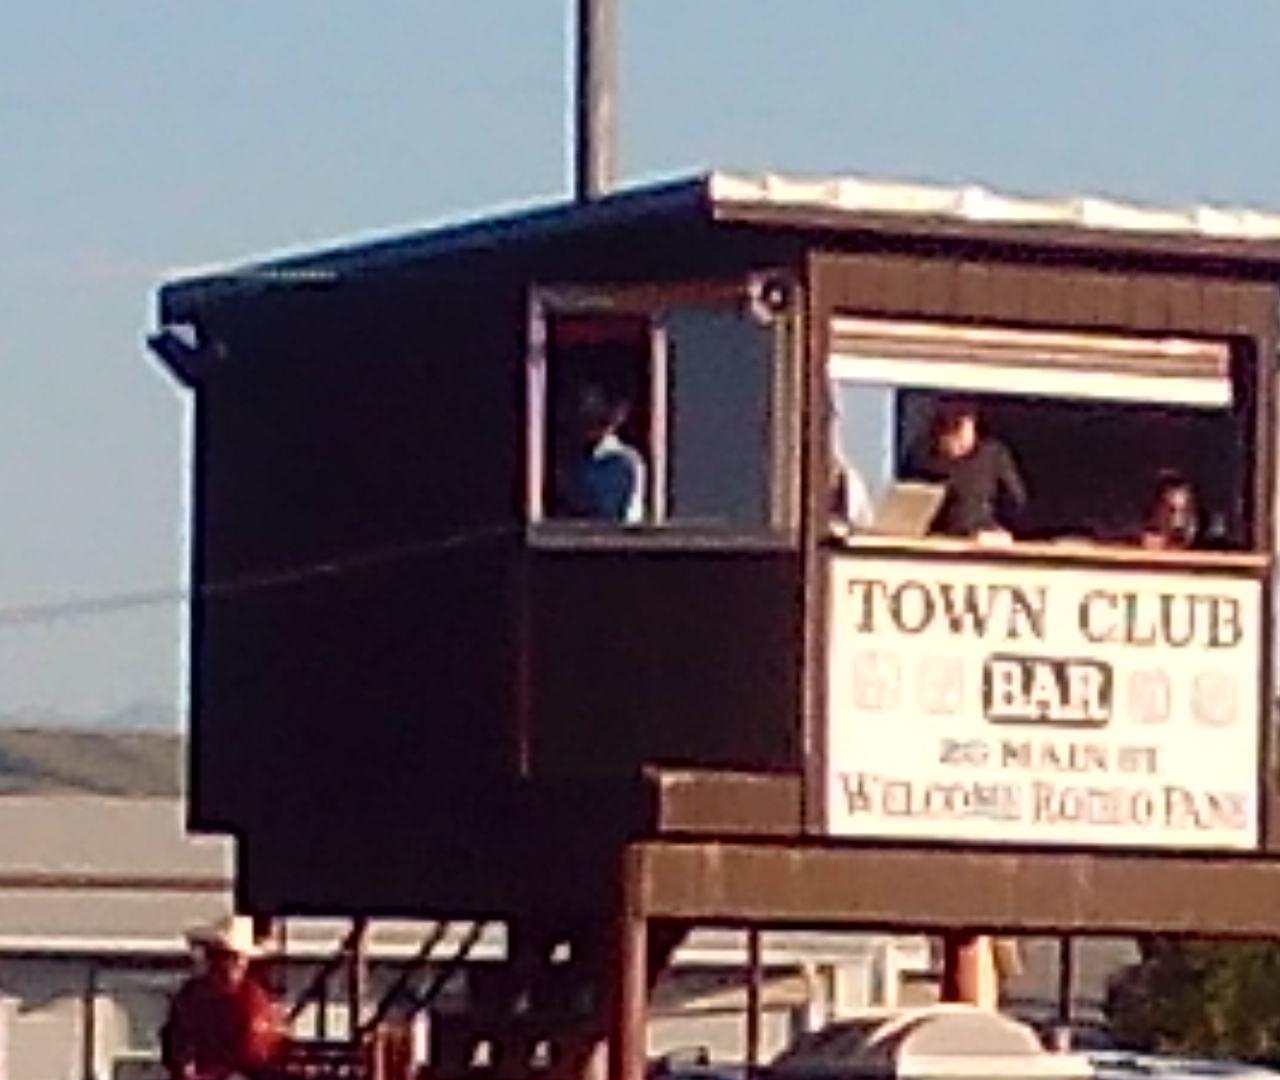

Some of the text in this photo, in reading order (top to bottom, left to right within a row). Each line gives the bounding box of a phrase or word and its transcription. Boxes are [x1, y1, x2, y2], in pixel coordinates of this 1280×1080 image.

[847, 579, 1244, 648] TOWN CLUB
[987, 661, 1111, 721] BAR
[1001, 738, 1108, 774] MAIN
[837, 771, 1249, 832] WELCOME RODEO FANS
